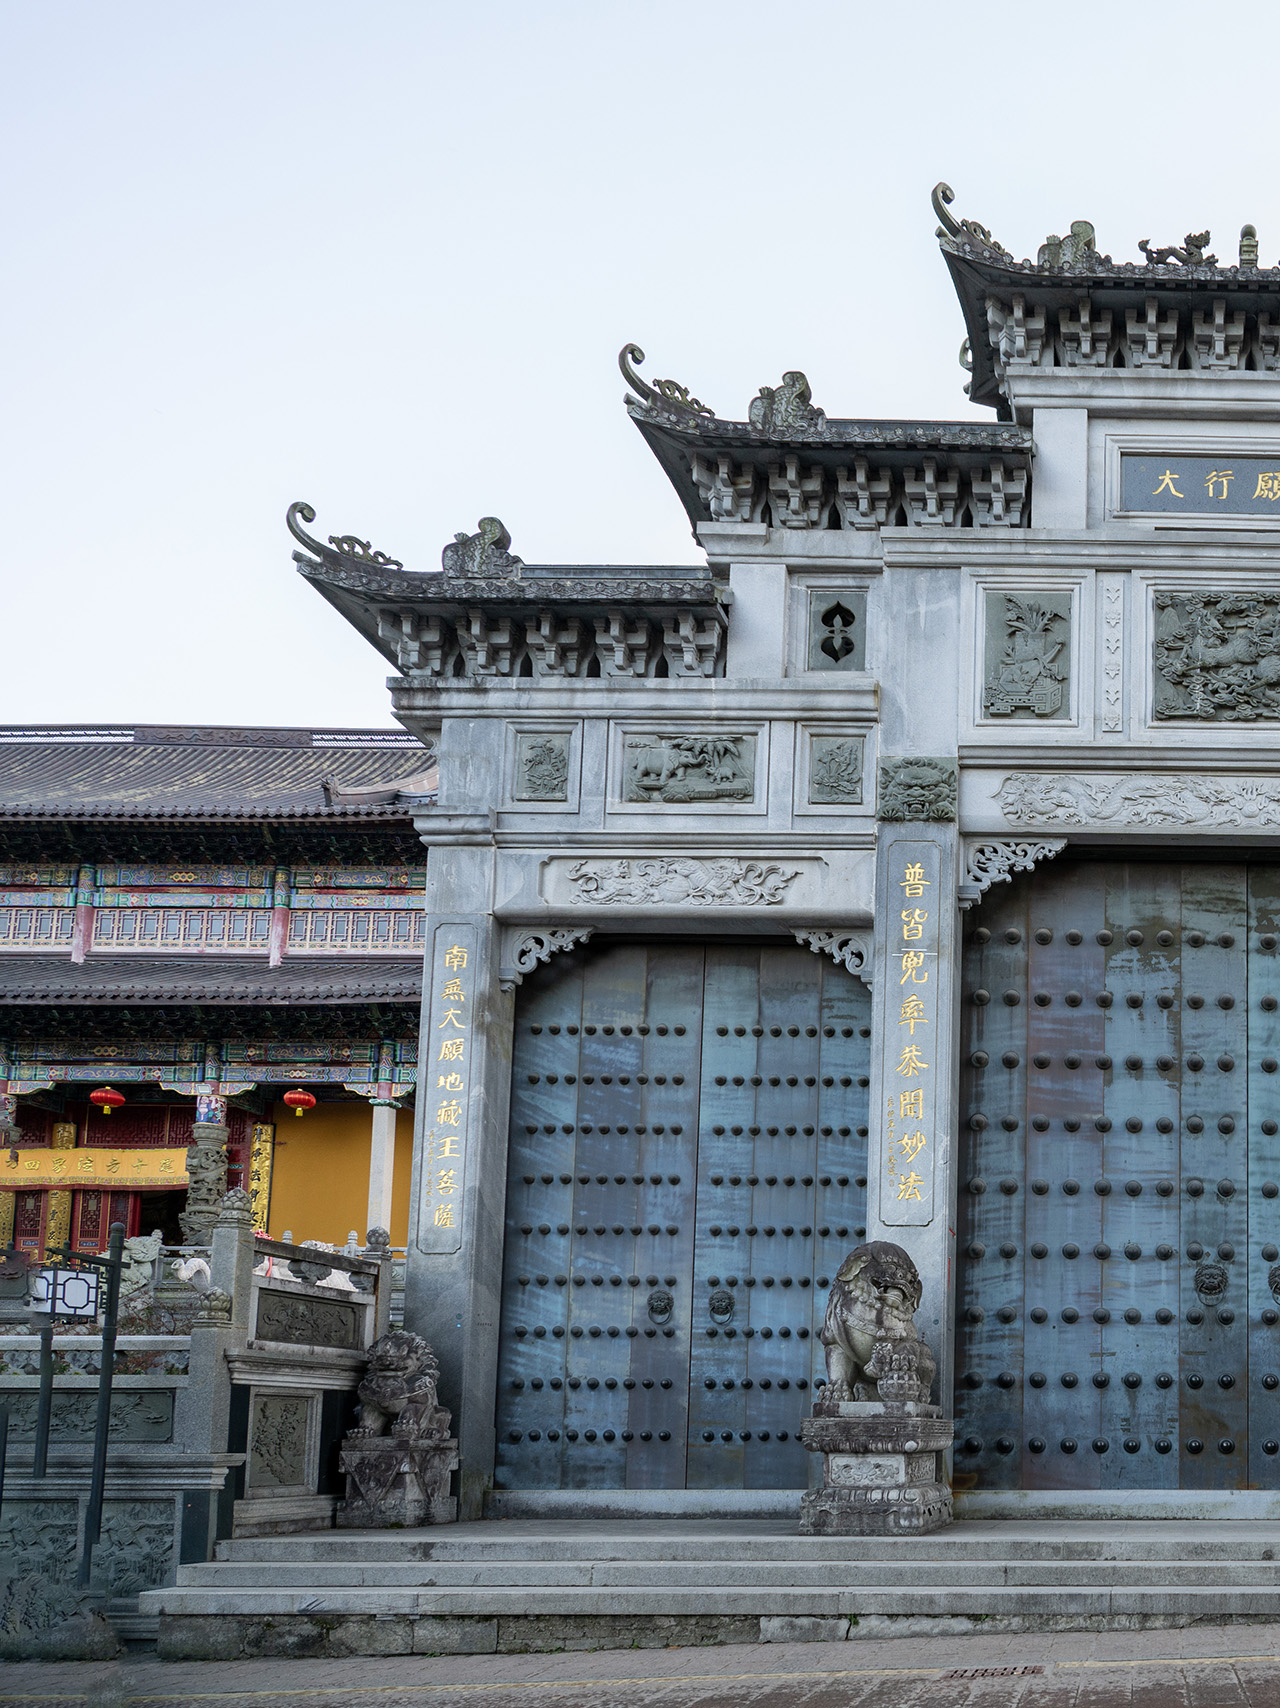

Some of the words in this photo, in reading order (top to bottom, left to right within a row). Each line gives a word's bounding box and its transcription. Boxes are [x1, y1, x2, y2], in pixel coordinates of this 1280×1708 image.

[434, 944, 468, 1229] 南無大願地藏王菩薩
